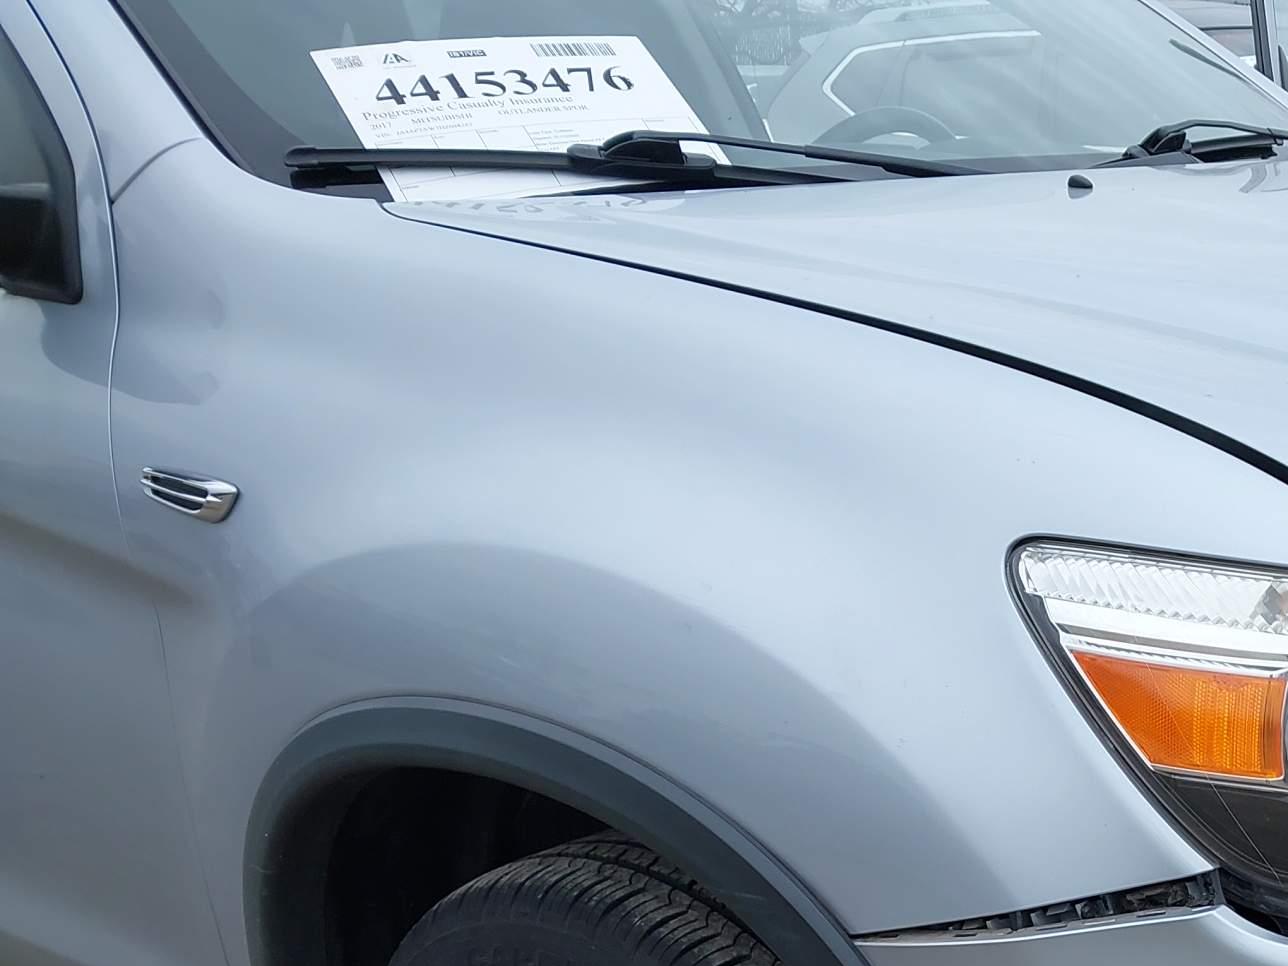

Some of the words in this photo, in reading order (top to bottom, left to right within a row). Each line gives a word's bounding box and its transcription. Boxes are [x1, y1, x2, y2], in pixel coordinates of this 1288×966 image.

[375, 65, 635, 106] 44153476
[361, 104, 444, 121] Progressive
[447, 97, 506, 111] Casualty
[509, 95, 574, 106] Insurance
